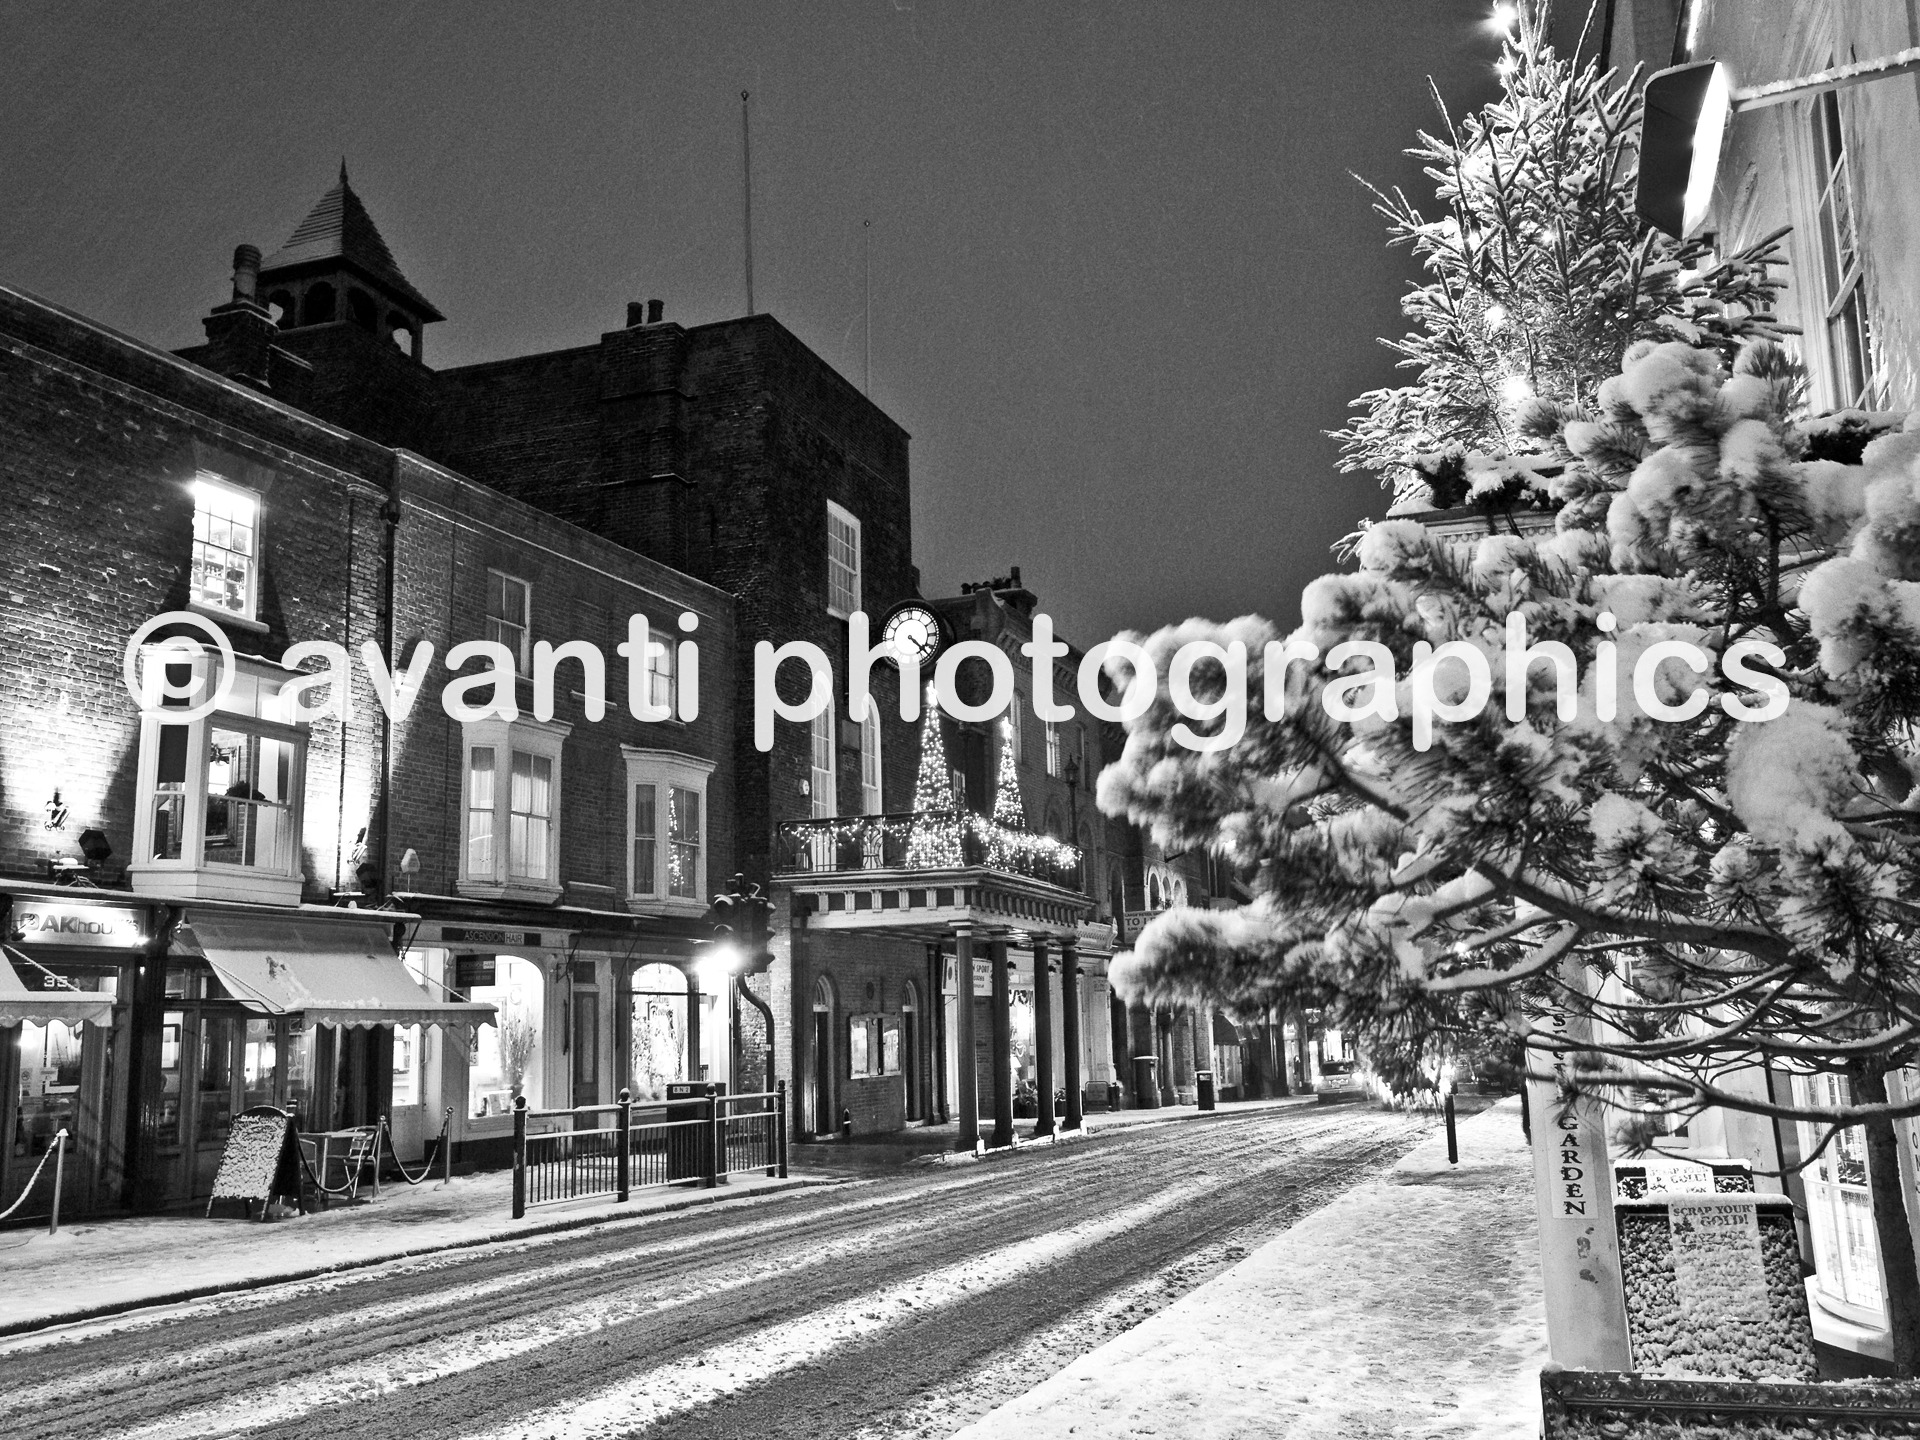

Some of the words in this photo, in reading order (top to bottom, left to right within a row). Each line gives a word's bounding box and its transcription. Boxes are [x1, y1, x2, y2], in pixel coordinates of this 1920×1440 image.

[1125, 918, 1140, 926] TO
[464, 930, 504, 942] ASCENSION
[505, 933, 523, 945] HAIR
[44, 976, 68, 987] 35
[1557, 1116, 1586, 1215] GARDEN
[1673, 1206, 1713, 1217] SCRAP
[1715, 1204, 1752, 1213] YOUR
[1700, 1213, 1749, 1227] GOLD!
